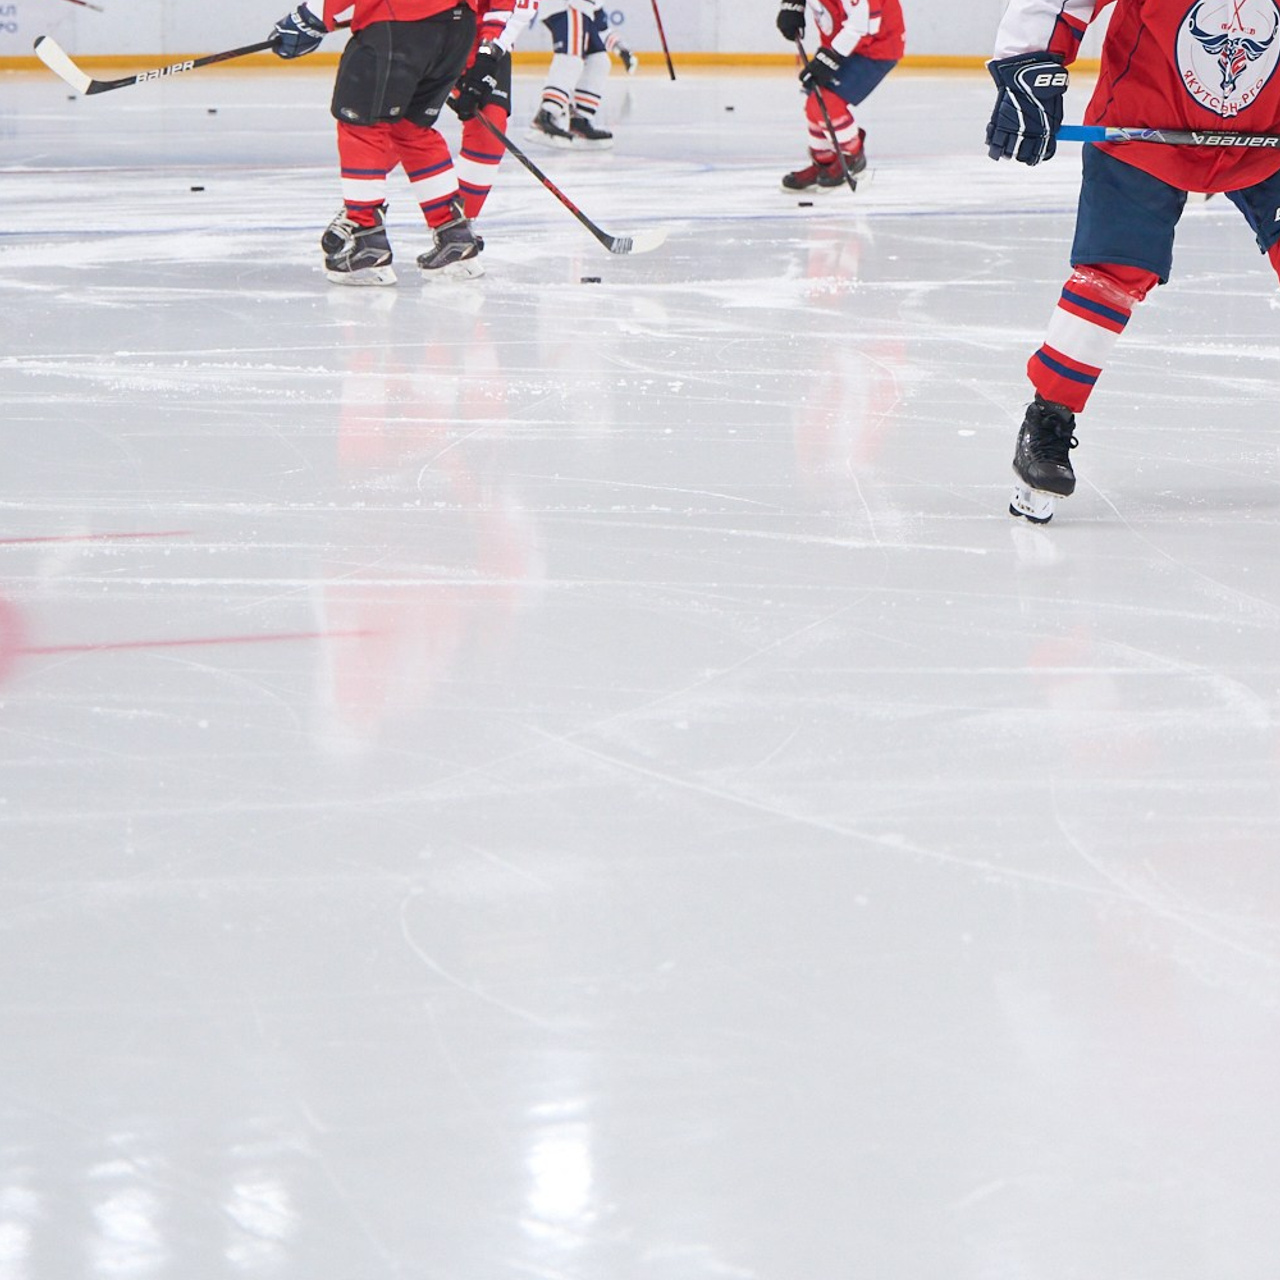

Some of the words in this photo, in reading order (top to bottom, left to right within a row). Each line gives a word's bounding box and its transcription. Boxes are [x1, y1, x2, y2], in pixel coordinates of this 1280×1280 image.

[136, 60, 195, 84] BAUER
[1034, 73, 1069, 87] BA
[1184, 69, 1264, 115] ЯКУТСЭНРГО
[1205, 135, 1279, 147] BAUER
